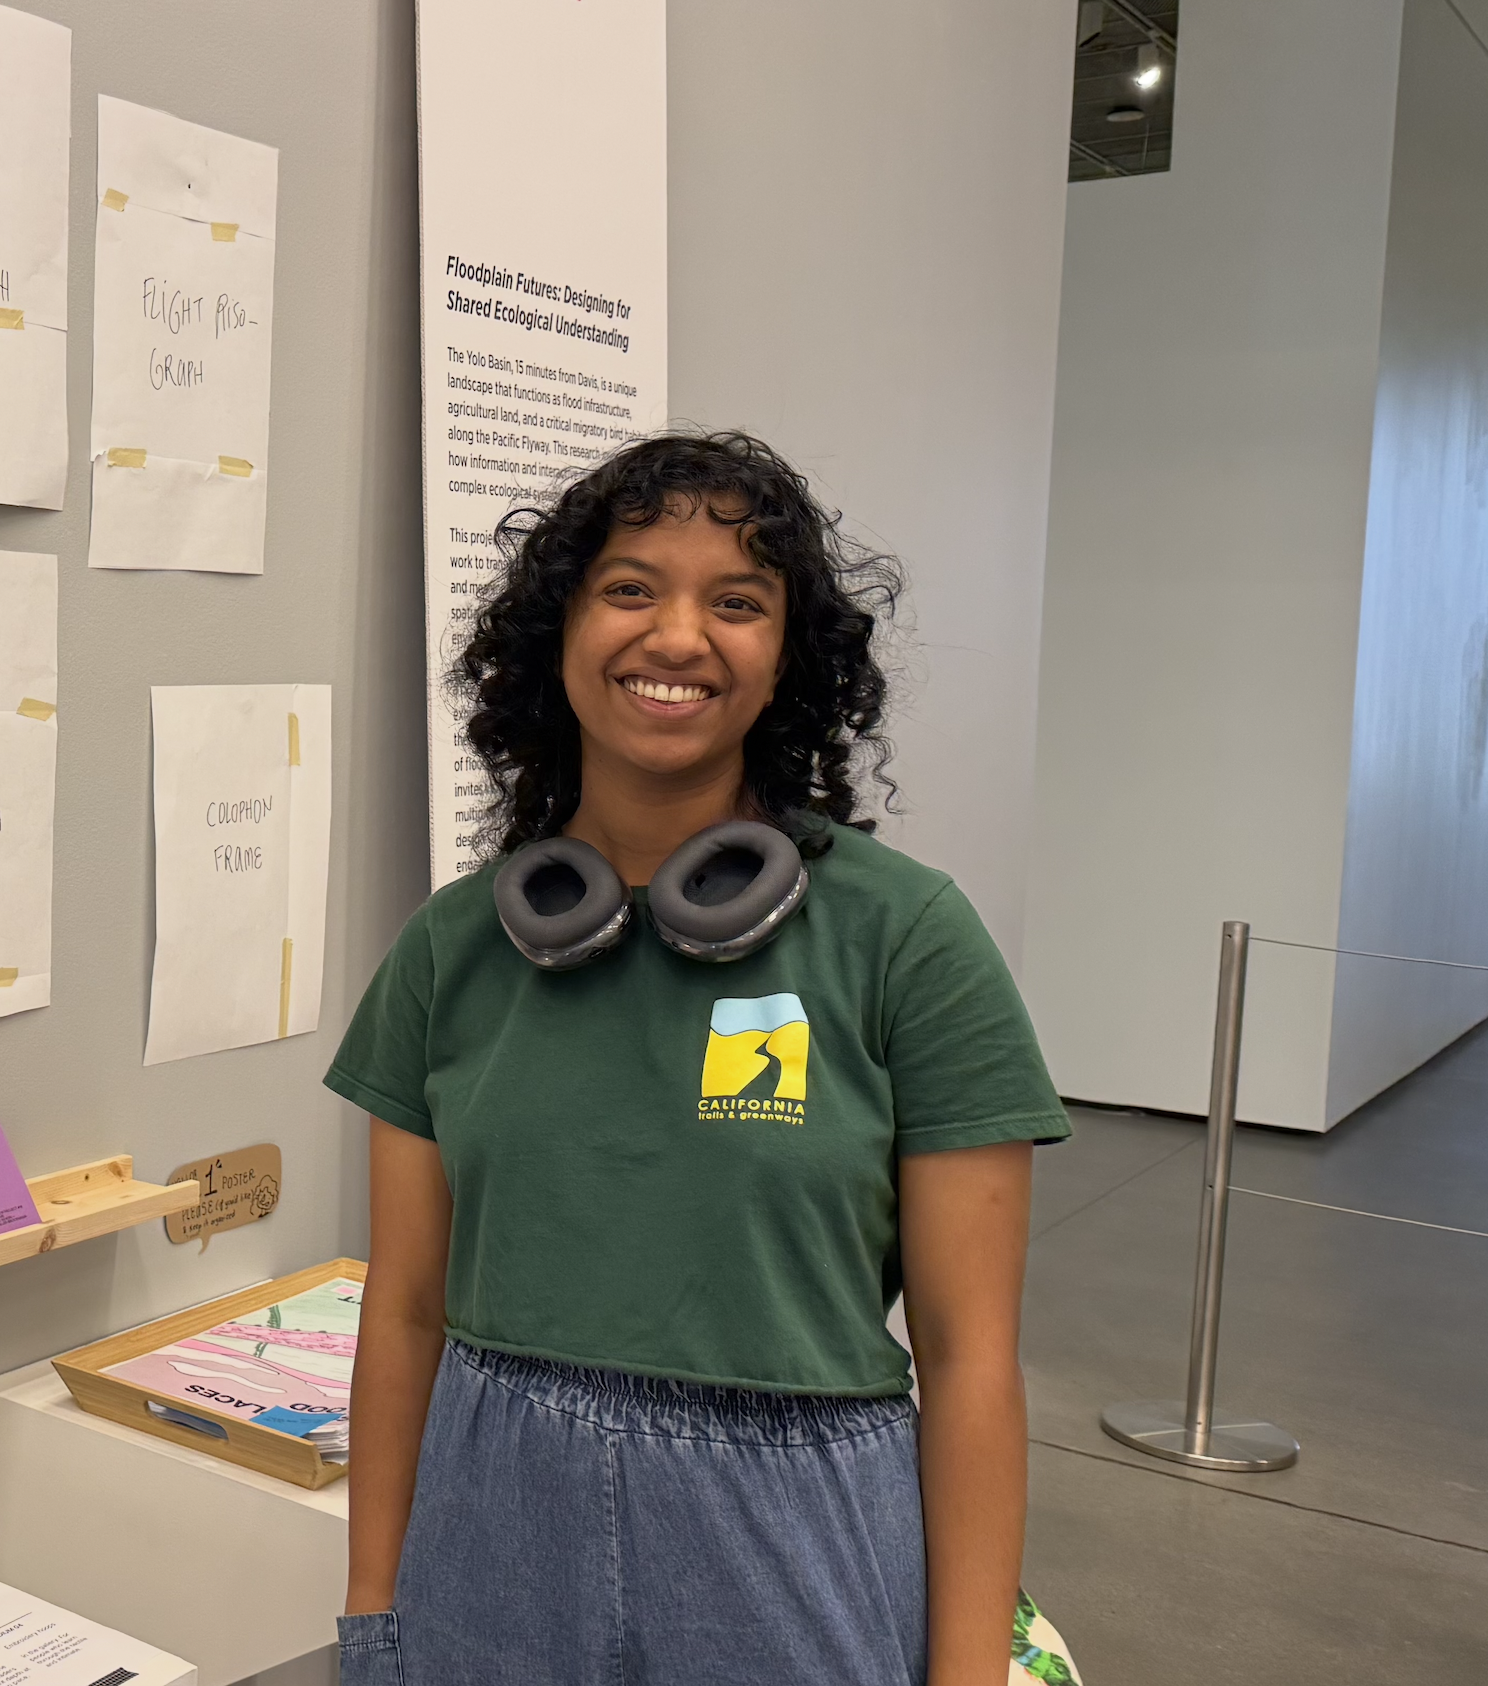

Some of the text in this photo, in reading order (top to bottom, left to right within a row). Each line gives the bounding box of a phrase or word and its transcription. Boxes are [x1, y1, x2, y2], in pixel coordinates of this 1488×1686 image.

[446, 255, 631, 320] Floodplain Futures: Designing for
[446, 290, 629, 353] Shared Ecological Understanding
[447, 346, 637, 398] The Yolo Basin, 15 minutes from Davis, is a unique
[447, 372, 632, 421] landscape that functions as flood infrastructure,
[448, 400, 624, 441] agricultural land, and a critical migratory bird
[448, 425, 601, 460] along the Pacific Flyway. This research
[448, 451, 537, 476] how information and
[449, 479, 487, 497] complex
[449, 527, 468, 543] This
[450, 554, 484, 570] work to
[450, 579, 468, 594] and
[206, 794, 273, 828] COLOPHON
[697, 1099, 806, 1116] CALIFORNIA
[698, 1110, 805, 1125] trails & greenways
[222, 1168, 256, 1190] POSTER
